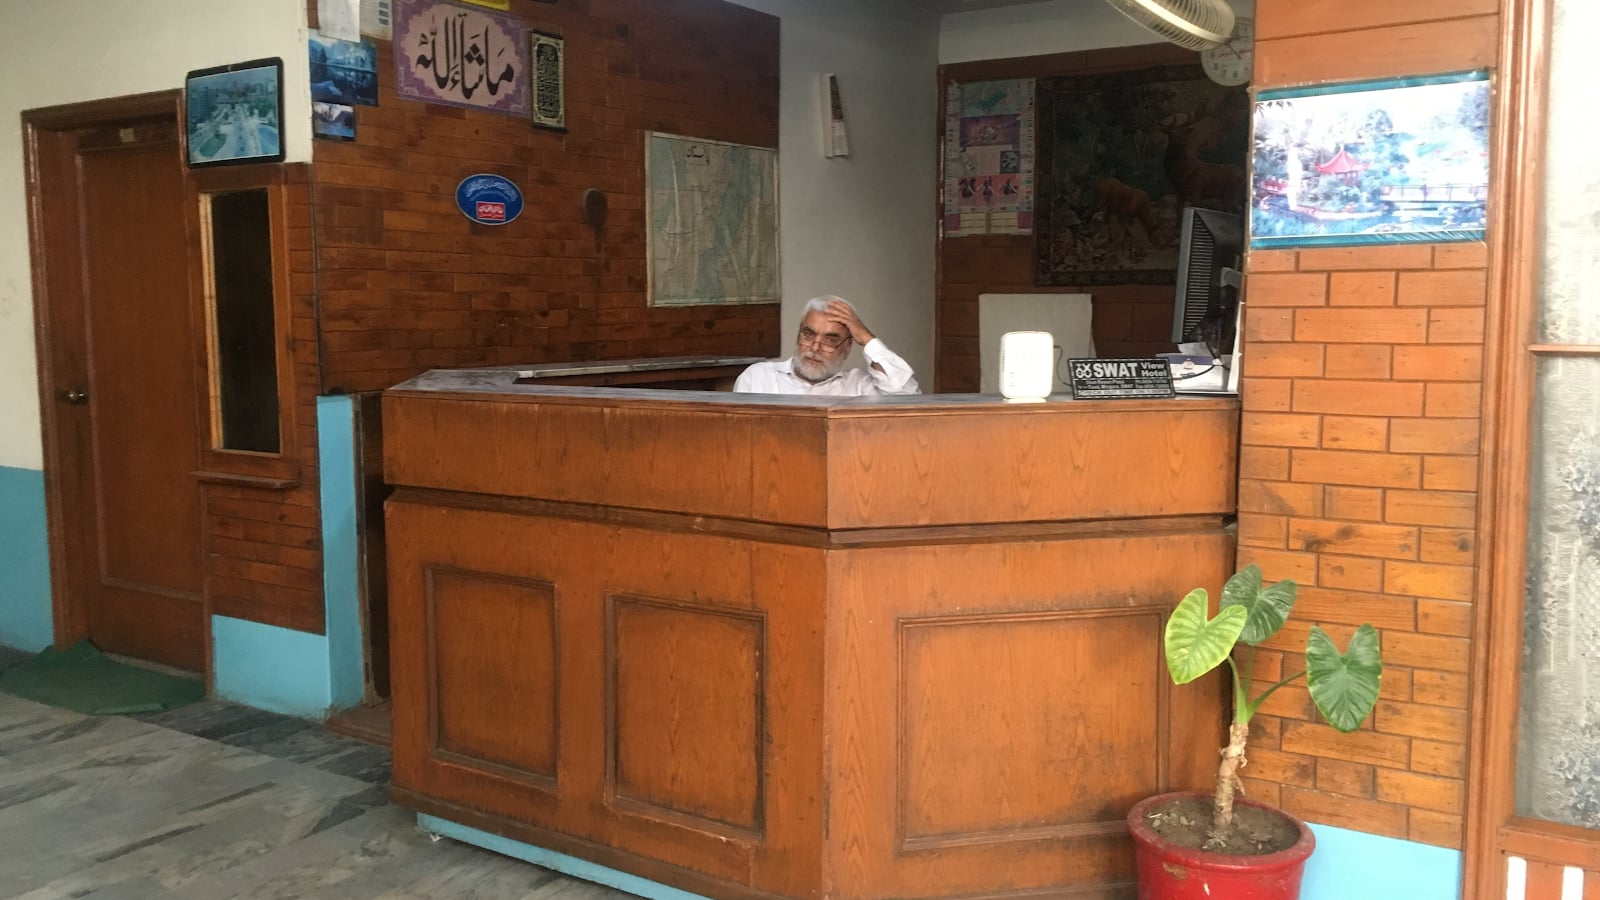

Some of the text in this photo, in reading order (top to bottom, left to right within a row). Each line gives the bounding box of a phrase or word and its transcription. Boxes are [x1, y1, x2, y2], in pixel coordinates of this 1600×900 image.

[1093, 362, 1138, 378] SWAT
[1140, 362, 1165, 370] View
[1141, 370, 1168, 378] Hotel
